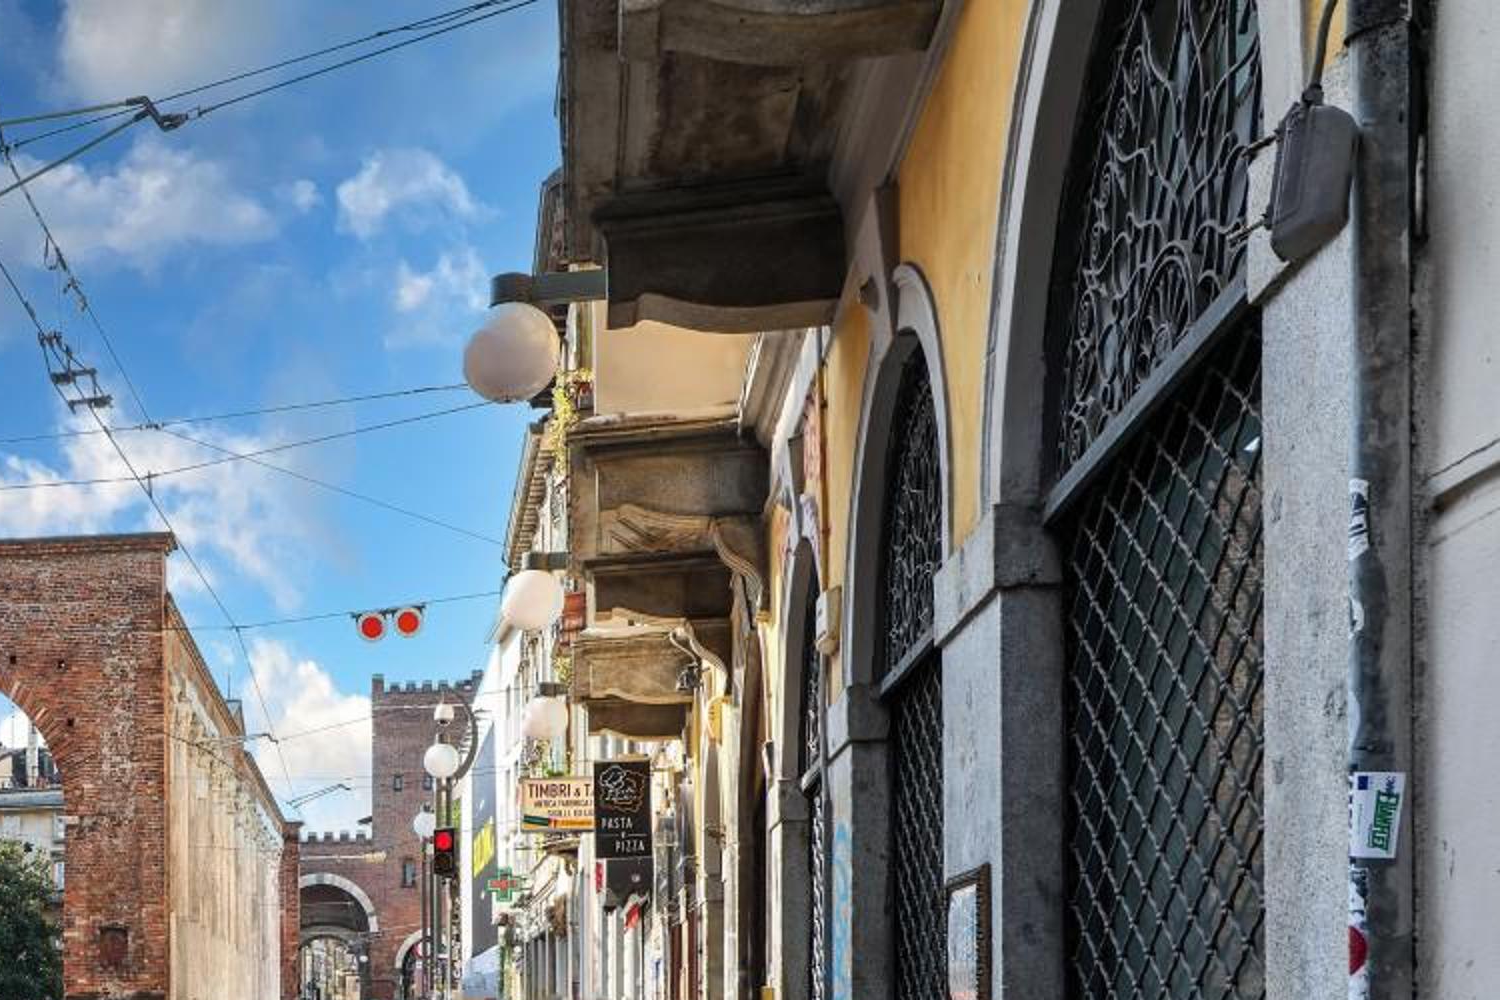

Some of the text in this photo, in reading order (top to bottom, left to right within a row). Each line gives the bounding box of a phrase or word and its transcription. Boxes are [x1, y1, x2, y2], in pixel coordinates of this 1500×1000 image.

[528, 783, 571, 798] TIMBRI
[601, 817, 633, 829] PASTA
[615, 840, 645, 853] PIZZA
